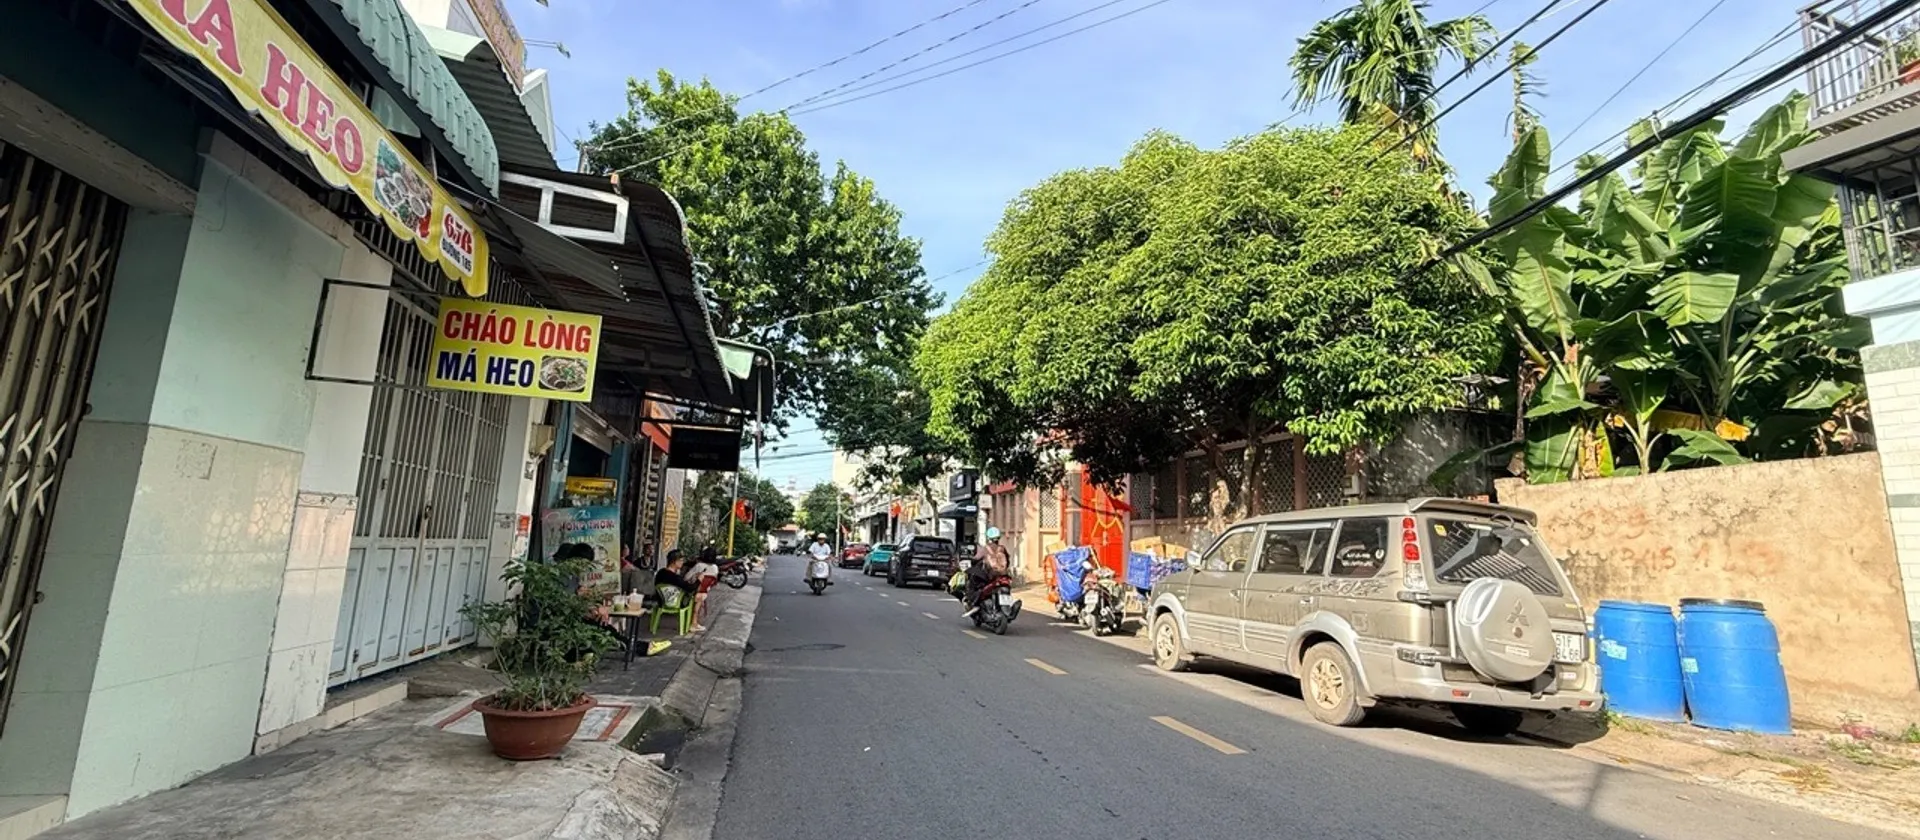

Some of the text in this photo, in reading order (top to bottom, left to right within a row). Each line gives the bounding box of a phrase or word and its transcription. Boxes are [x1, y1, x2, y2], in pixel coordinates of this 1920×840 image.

[260, 42, 364, 175] HEO
[444, 213, 473, 255] 65B
[443, 309, 593, 353] CHÁO LÒNG
[436, 347, 536, 388] MÁ HEO
[1555, 634, 1573, 648] 51F
